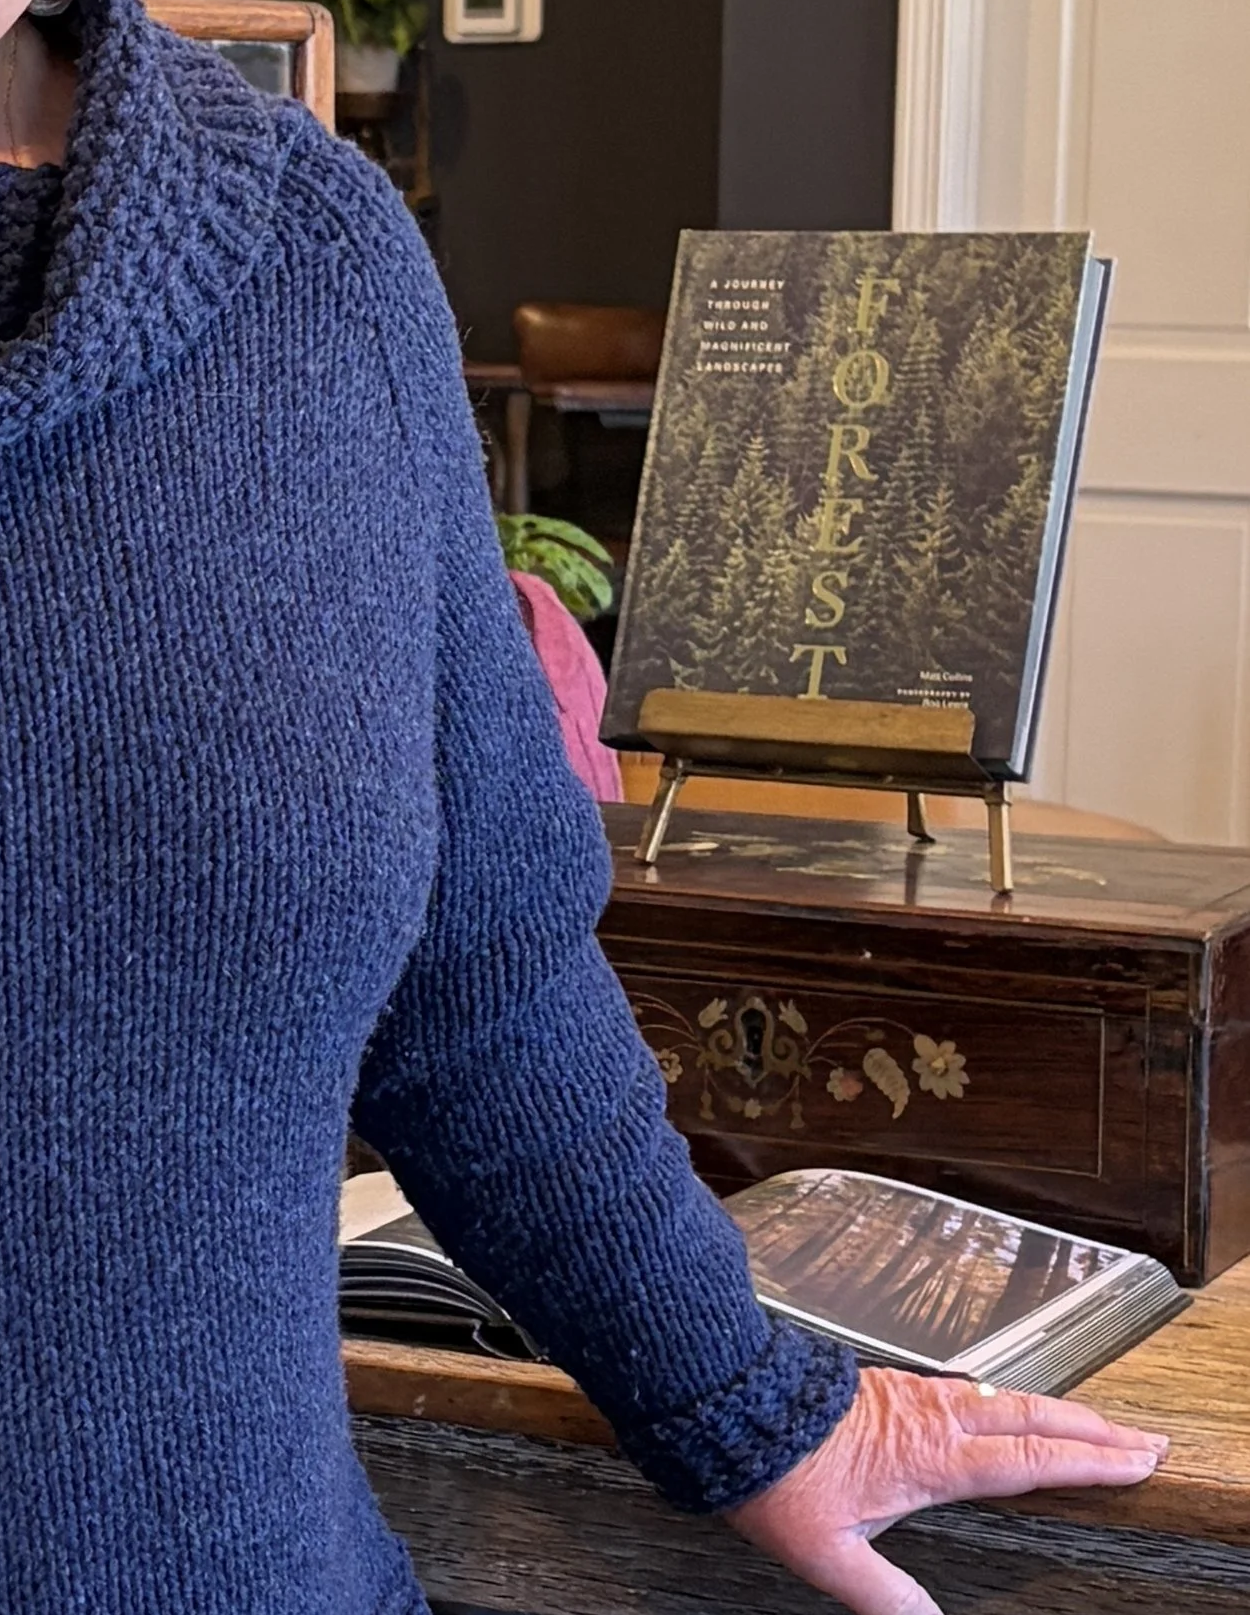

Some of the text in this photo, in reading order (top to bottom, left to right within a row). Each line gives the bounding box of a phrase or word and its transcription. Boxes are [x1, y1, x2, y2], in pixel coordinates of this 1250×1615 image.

[710, 278, 786, 291] A JOURNEY
[707, 299, 770, 311] THROUGH
[703, 320, 769, 332] WILD AND
[700, 341, 791, 353] MAGNIFICENT
[696, 361, 783, 374] LANDSCAPES
[789, 277, 902, 701] FOREST
[942, 671, 973, 683] Collins
